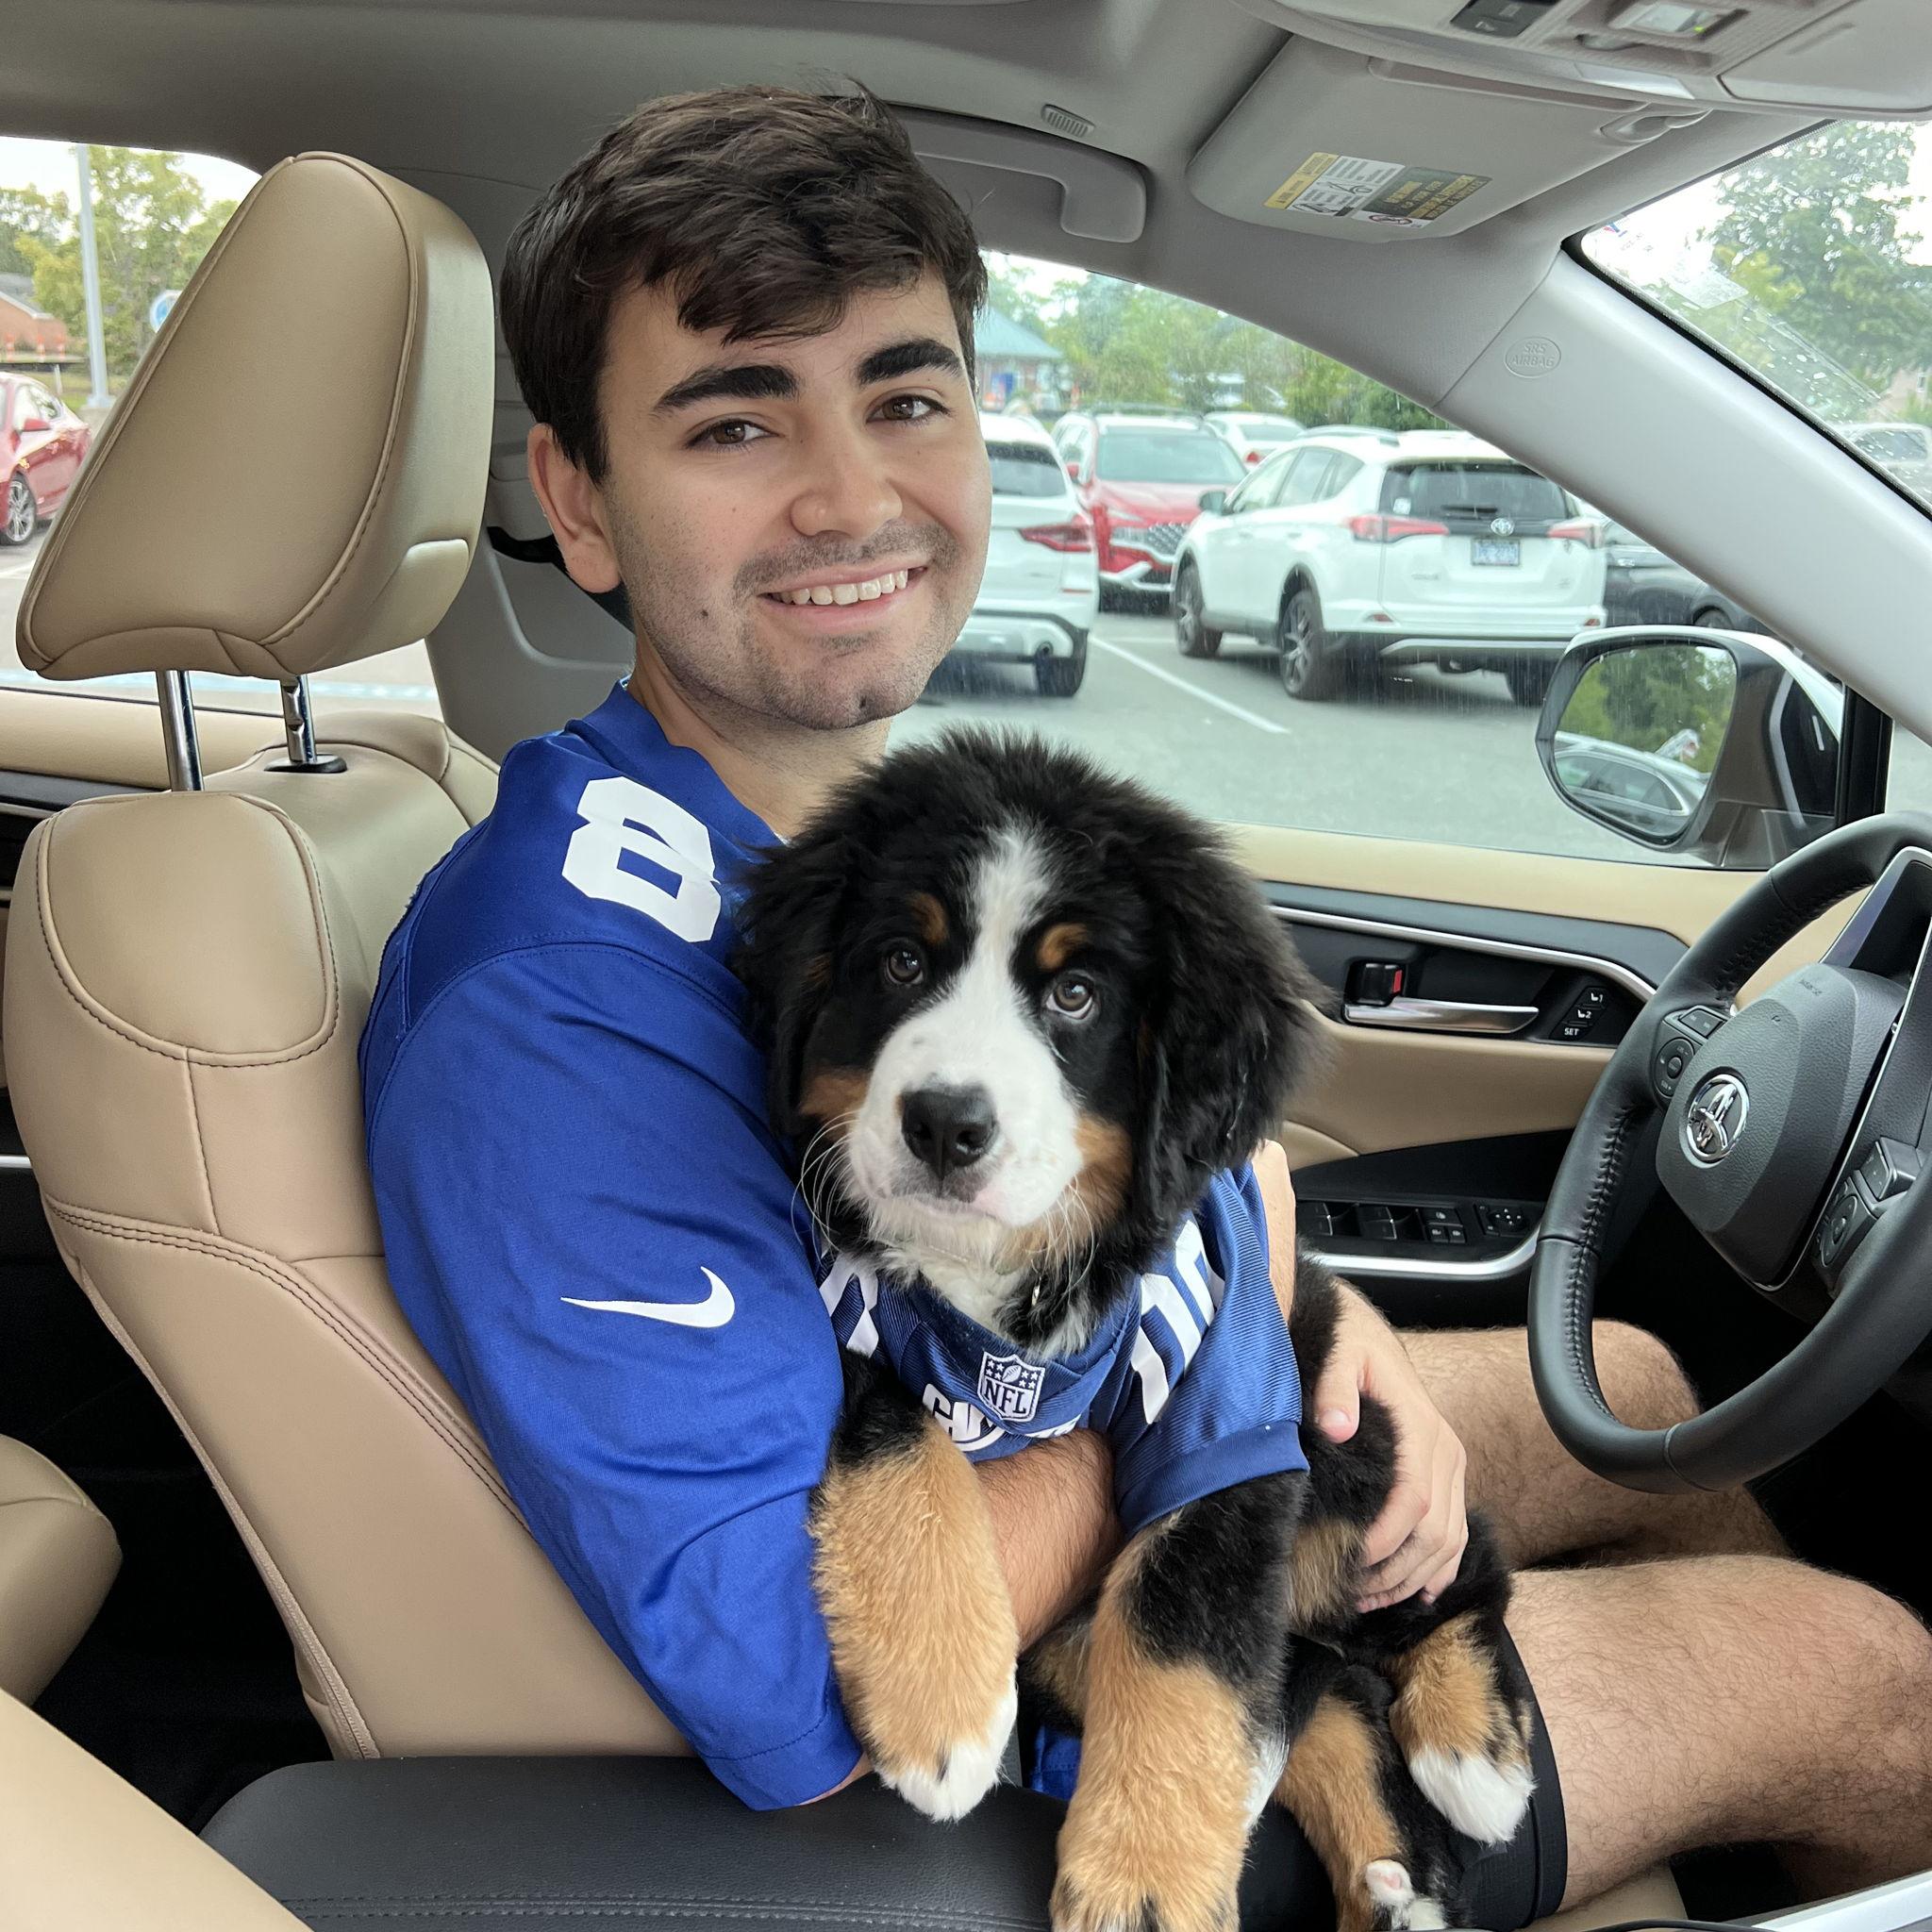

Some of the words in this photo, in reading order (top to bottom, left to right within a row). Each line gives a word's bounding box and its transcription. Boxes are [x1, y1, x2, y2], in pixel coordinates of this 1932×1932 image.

[1524, 341, 1547, 354] SRS
[1510, 355, 1556, 369] AIRBAG
[561, 775, 722, 942] 8
[1564, 1027, 1580, 1036] SET
[983, 1379, 1028, 1414] NFL
